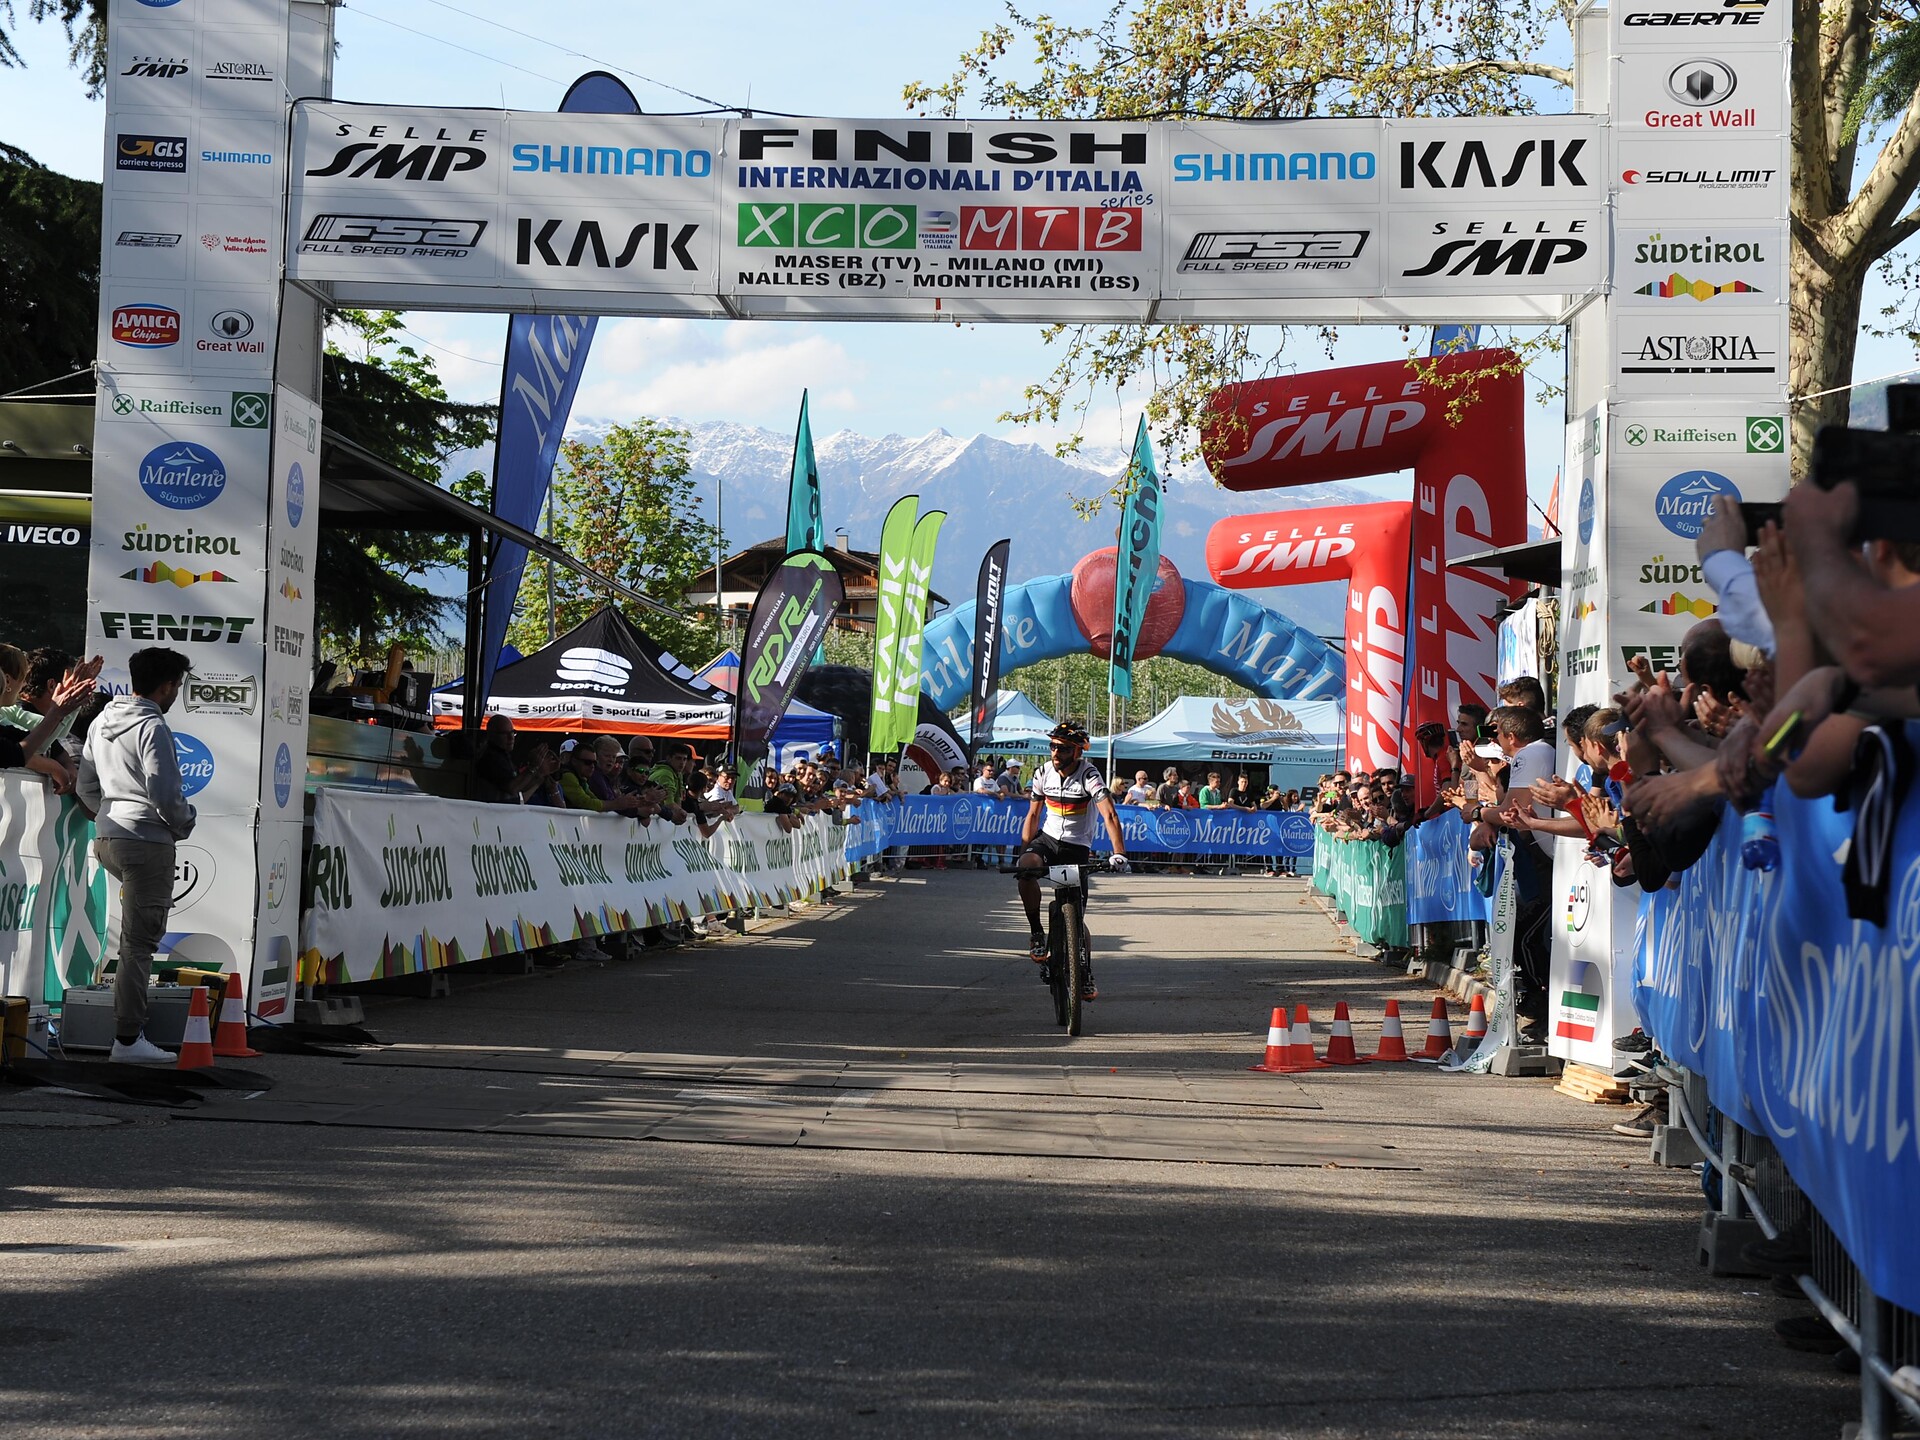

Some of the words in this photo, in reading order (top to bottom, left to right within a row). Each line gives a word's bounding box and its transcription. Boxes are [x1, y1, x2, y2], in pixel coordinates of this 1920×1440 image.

[132, 55, 189, 64] SELLE
[213, 62, 266, 76] ASTORIA
[121, 62, 189, 79] SMP
[1644, 110, 1703, 128] Great
[1709, 108, 1756, 127] Wall
[335, 123, 488, 143] SELLE
[153, 141, 185, 158] GLS
[201, 151, 272, 164] SHIMANO
[739, 129, 1147, 165] FINISH
[119, 158, 149, 168] corriere
[150, 160, 184, 169] espresso
[305, 143, 488, 182] SMP
[512, 144, 712, 178] SHIMANO
[1174, 152, 1376, 182] SHIMANO
[1400, 139, 1588, 188] KASK
[738, 166, 1000, 191] INTERNAZIONALI
[1014, 169, 1143, 192] D'ITALIA
[1645, 170, 1777, 183] SOULLIMIT
[1698, 182, 1737, 190] evoluzione
[1738, 182, 1768, 190] sportiva
[1100, 191, 1154, 209] series
[744, 205, 910, 246] XCO
[965, 208, 1133, 249] MTB
[1432, 220, 1588, 235] SELLE
[302, 244, 349, 255] FULL
[350, 245, 406, 256] SPEED
[411, 247, 468, 259] AHEAD
[516, 218, 699, 271] KASK
[774, 255, 863, 270] MASER
[871, 255, 921, 273] (TV)
[948, 257, 1045, 272] MILANO
[1054, 257, 1104, 274] (MI)
[1183, 261, 1225, 271] FULL
[1232, 260, 1289, 271] SPEED
[1294, 259, 1352, 271] AHEAD
[1402, 238, 1588, 277] SMP
[738, 272, 830, 286] NALLES
[838, 272, 887, 290] (BZ)
[913, 274, 1081, 289] MONTICHIARI
[1090, 274, 1140, 291] (BS)
[115, 312, 177, 330] AMICA
[132, 329, 161, 342] Chips
[196, 339, 232, 352] Great
[236, 341, 265, 353] Wall
[1638, 336, 1760, 360] ASTORIA
[140, 398, 223, 416] Raiffeisen
[1252, 381, 1423, 417] SELLE
[1223, 400, 1427, 467] SMP
[1652, 428, 1738, 442] Raiffeisen
[159, 490, 206, 505] SÜDTIROL
[1658, 495, 1717, 516] Marle
[7, 525, 81, 546] IVECO
[1238, 523, 1354, 544] SELLE
[1220, 537, 1356, 576] SMP
[1419, 482, 1438, 700] ELLE
[99, 611, 255, 644] FENDT
[875, 552, 905, 712] KASK
[894, 558, 930, 707] KASK
[980, 556, 999, 699] SOULLIMIT
[274, 625, 305, 658] FENDT
[783, 643, 801, 673] ITALIANO
[1566, 645, 1601, 677] FENDT
[1351, 588, 1363, 775] SELLE
[1367, 585, 1404, 769] SMP
[190, 684, 251, 703] FORST
[550, 681, 626, 696] sportful
[532, 703, 576, 714] sportful
[606, 706, 650, 719] sportful
[679, 710, 724, 721] sportful
[1211, 750, 1274, 761] Bianchi
[896, 804, 947, 834] Marlene
[1158, 824, 1189, 836] Marlene
[1193, 818, 1270, 845] Marlene
[1061, 869, 1067, 881] 1
[1497, 868, 1510, 918] Raiffeisen
[1491, 1000, 1506, 1033] Raiffeisen
